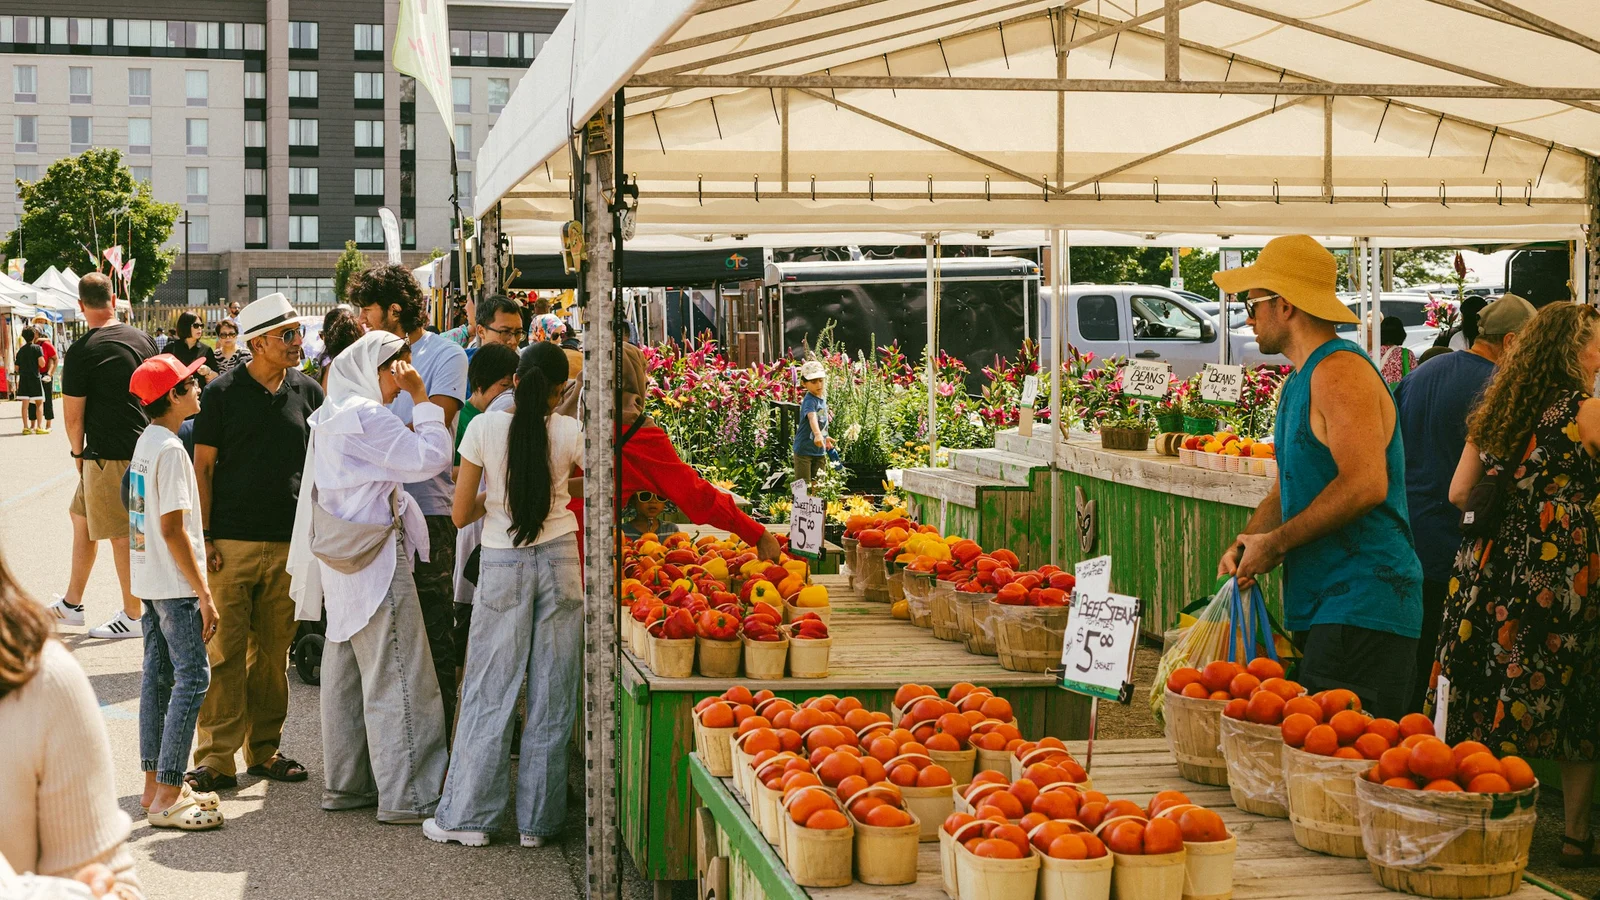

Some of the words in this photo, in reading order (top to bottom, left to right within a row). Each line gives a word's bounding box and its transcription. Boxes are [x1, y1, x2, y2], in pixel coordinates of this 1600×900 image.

[725, 253, 749, 270] OTC
[1130, 369, 1165, 384] BEANS
[1208, 368, 1237, 385] BEANS
[794, 497, 809, 512] SWEET
